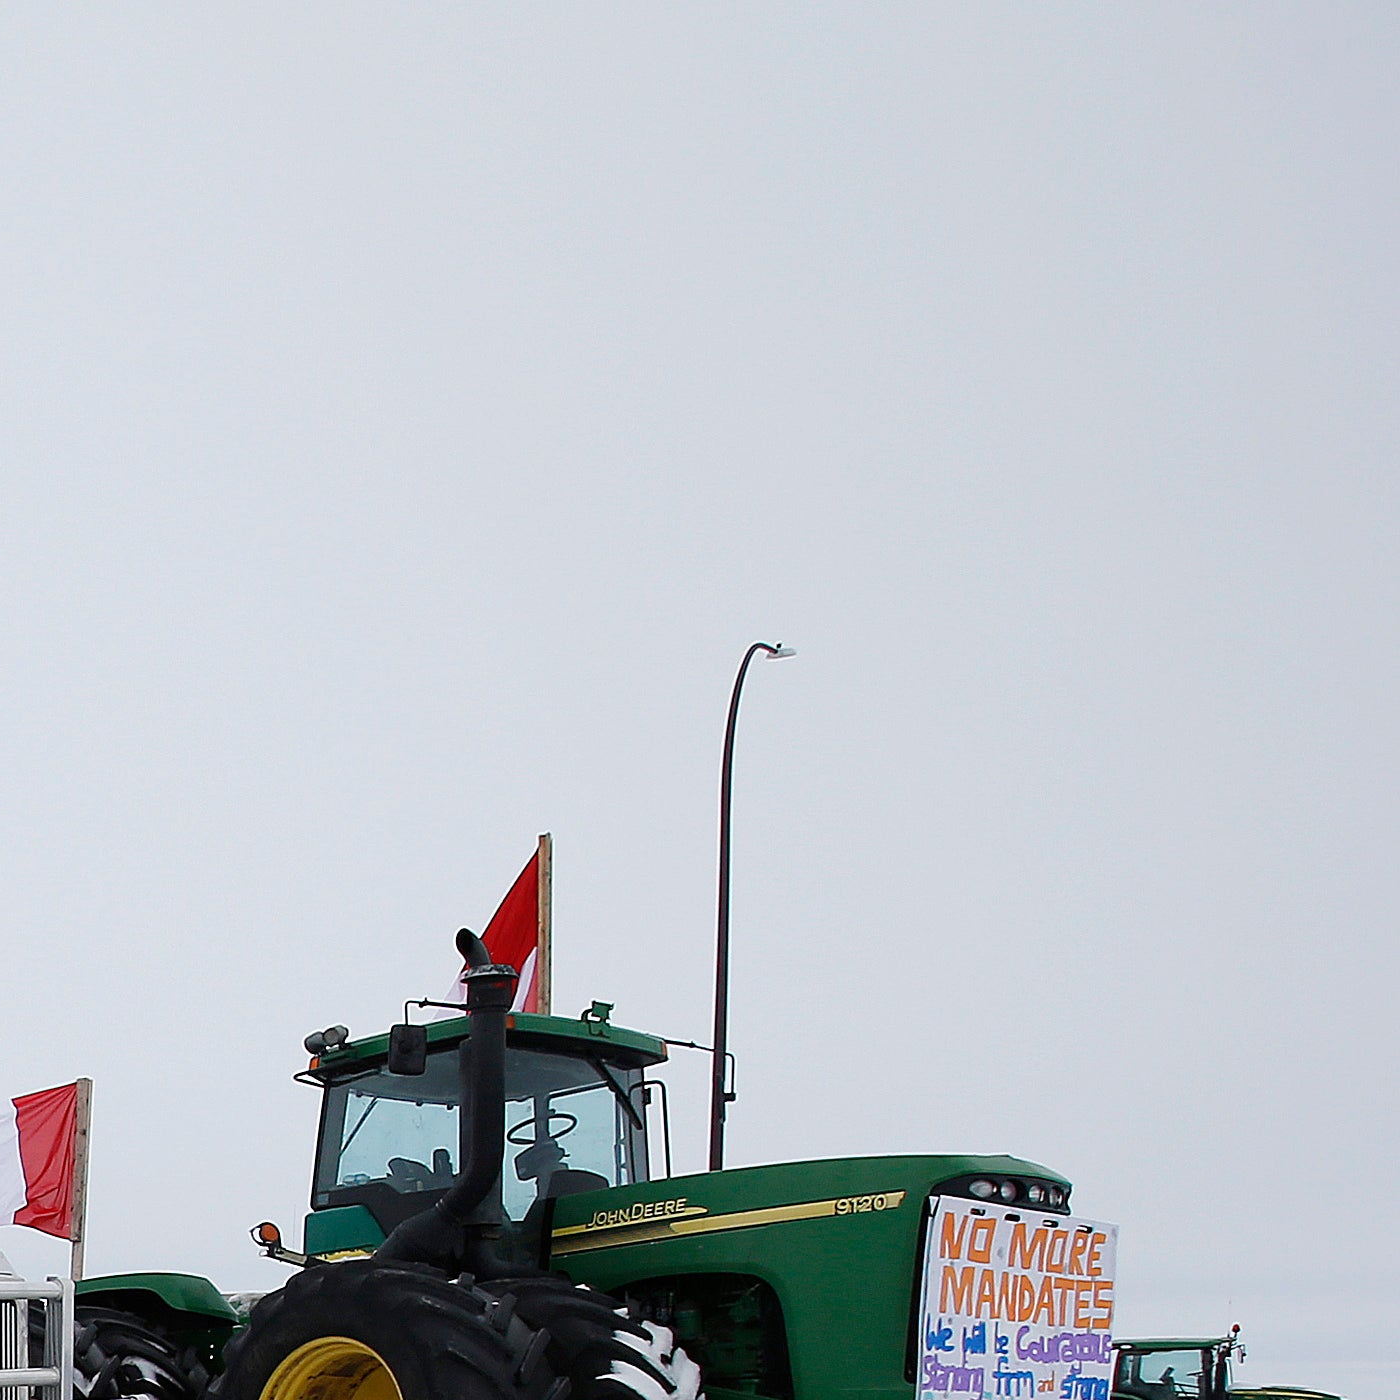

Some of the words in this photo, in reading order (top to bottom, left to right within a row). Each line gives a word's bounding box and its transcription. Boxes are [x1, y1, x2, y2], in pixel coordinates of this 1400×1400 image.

[587, 1207, 631, 1227] JOHN
[631, 1197, 688, 1219] DEERE
[836, 1194, 887, 1215] 9120
[939, 1212, 997, 1264] NO
[1008, 1222, 1106, 1277] MORE
[939, 1265, 1114, 1329] MANDATES
[925, 1313, 955, 1352] We
[962, 1322, 986, 1354] will
[994, 1321, 1009, 1354] be
[992, 1356, 1034, 1398] firm
[1037, 1370, 1055, 1393] and
